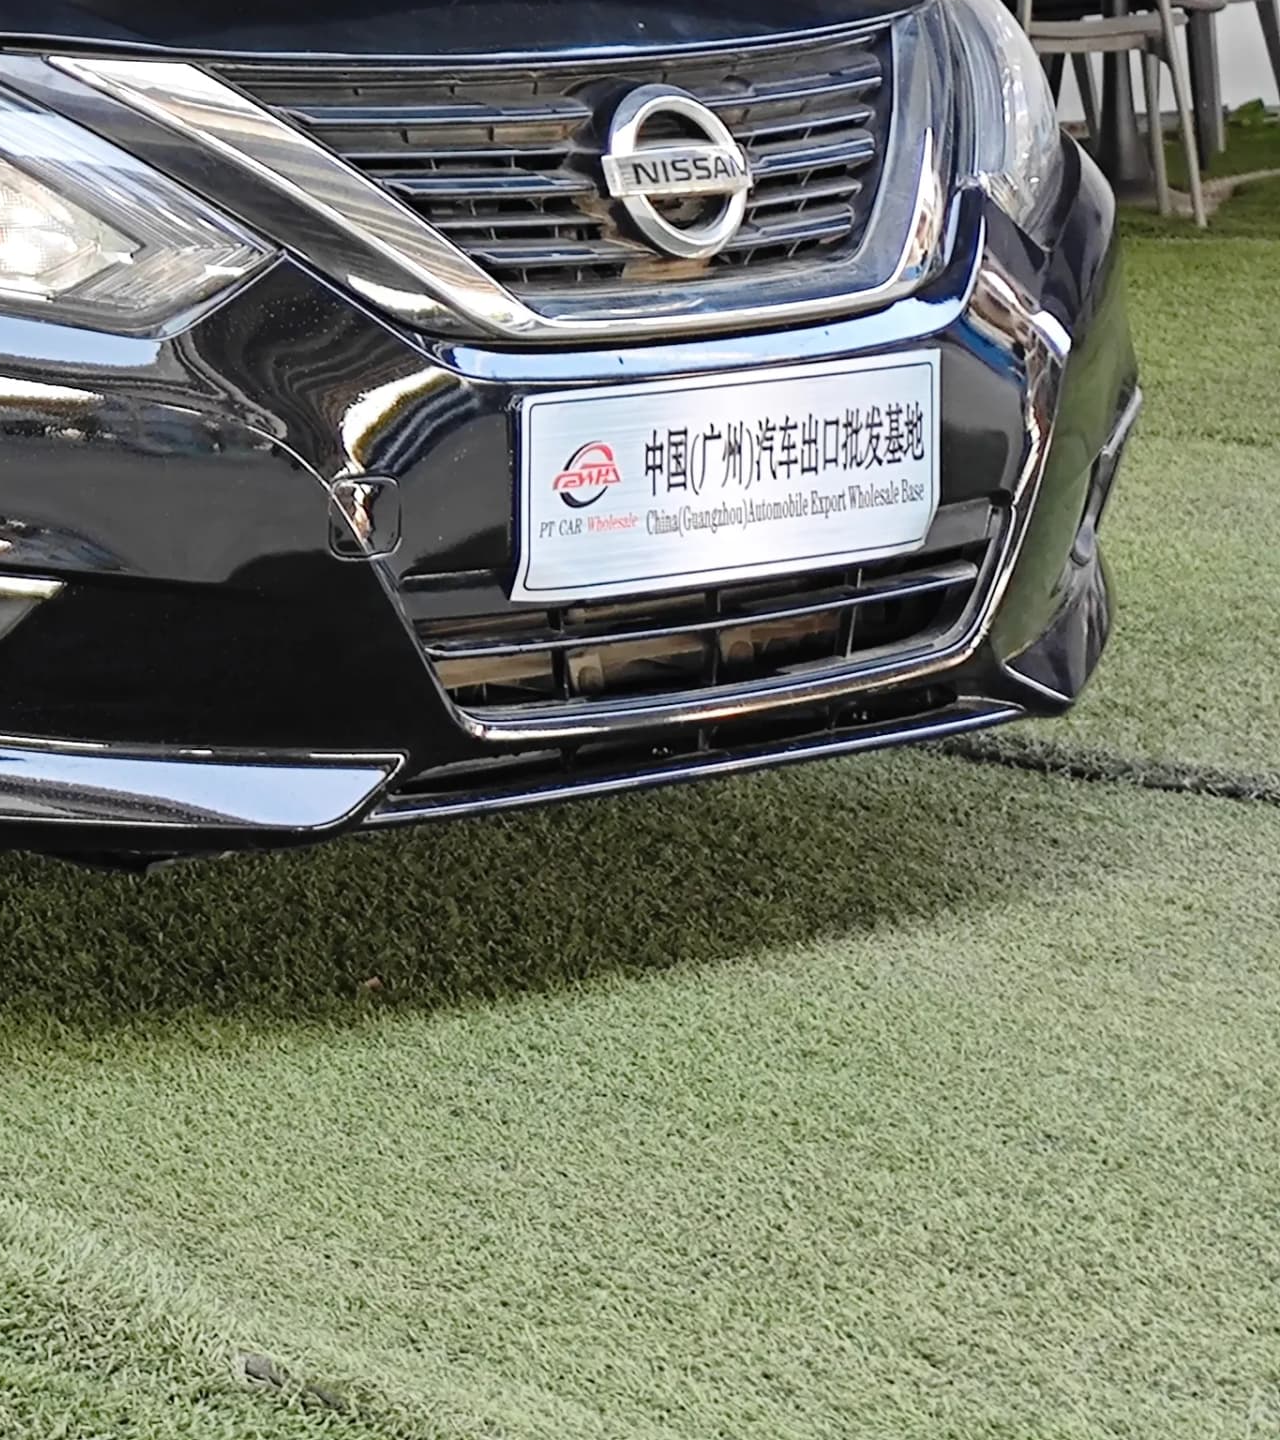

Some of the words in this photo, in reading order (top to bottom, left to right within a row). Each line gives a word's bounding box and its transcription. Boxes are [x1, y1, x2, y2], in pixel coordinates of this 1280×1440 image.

[632, 154, 747, 185] NISSAN
[644, 401, 926, 497] 中国(广州)汽车出口批发基地
[811, 490, 846, 519] Export
[848, 480, 900, 512] Wholesale
[901, 477, 926, 504] Base
[540, 521, 556, 539] PT
[559, 518, 584, 537] CAR
